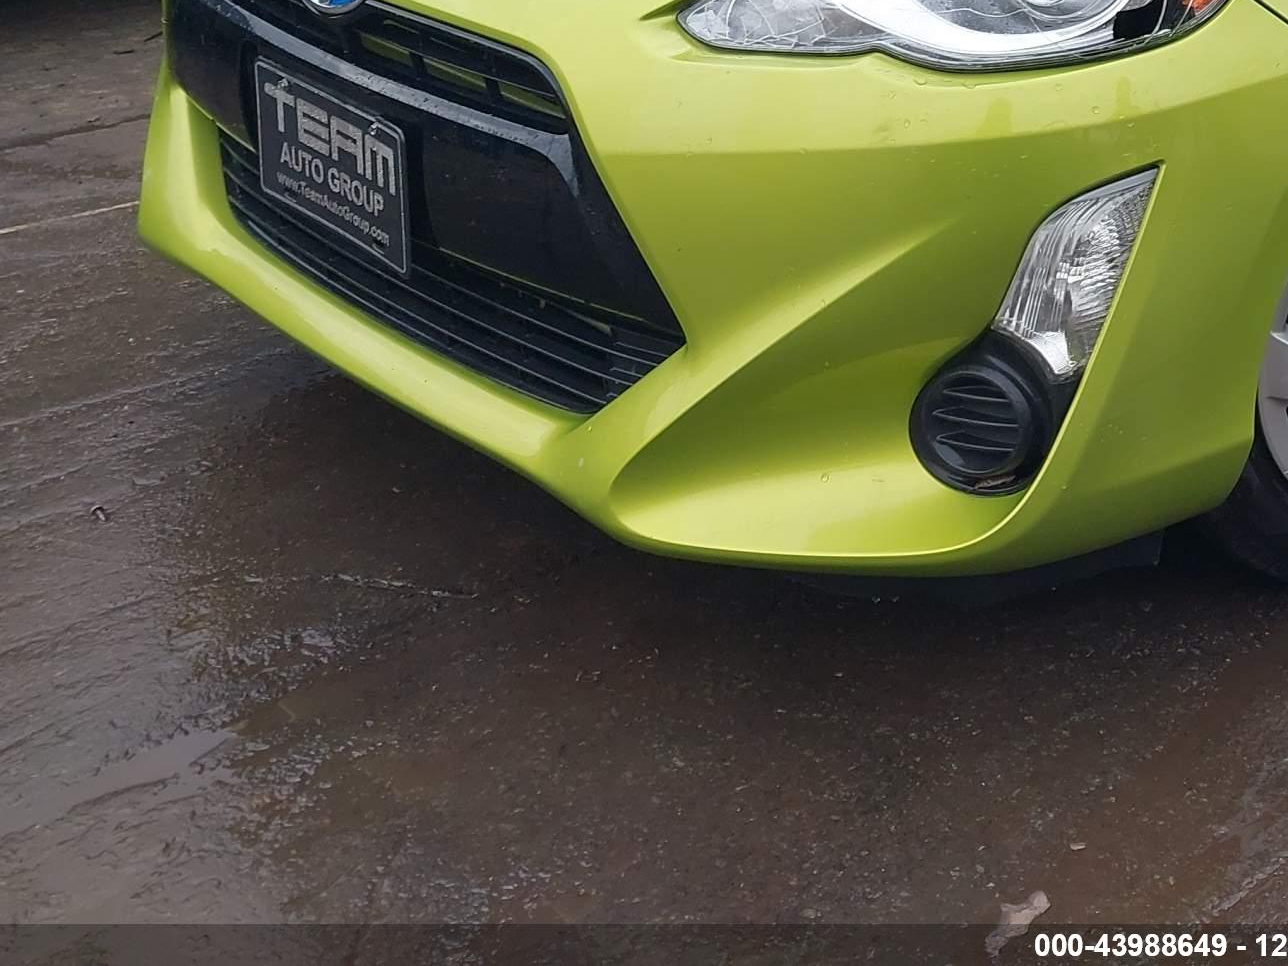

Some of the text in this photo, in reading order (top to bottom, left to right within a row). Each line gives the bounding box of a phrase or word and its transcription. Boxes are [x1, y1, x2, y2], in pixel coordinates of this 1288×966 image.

[264, 82, 397, 196] TEAM
[280, 142, 385, 217] AUTO GROUP
